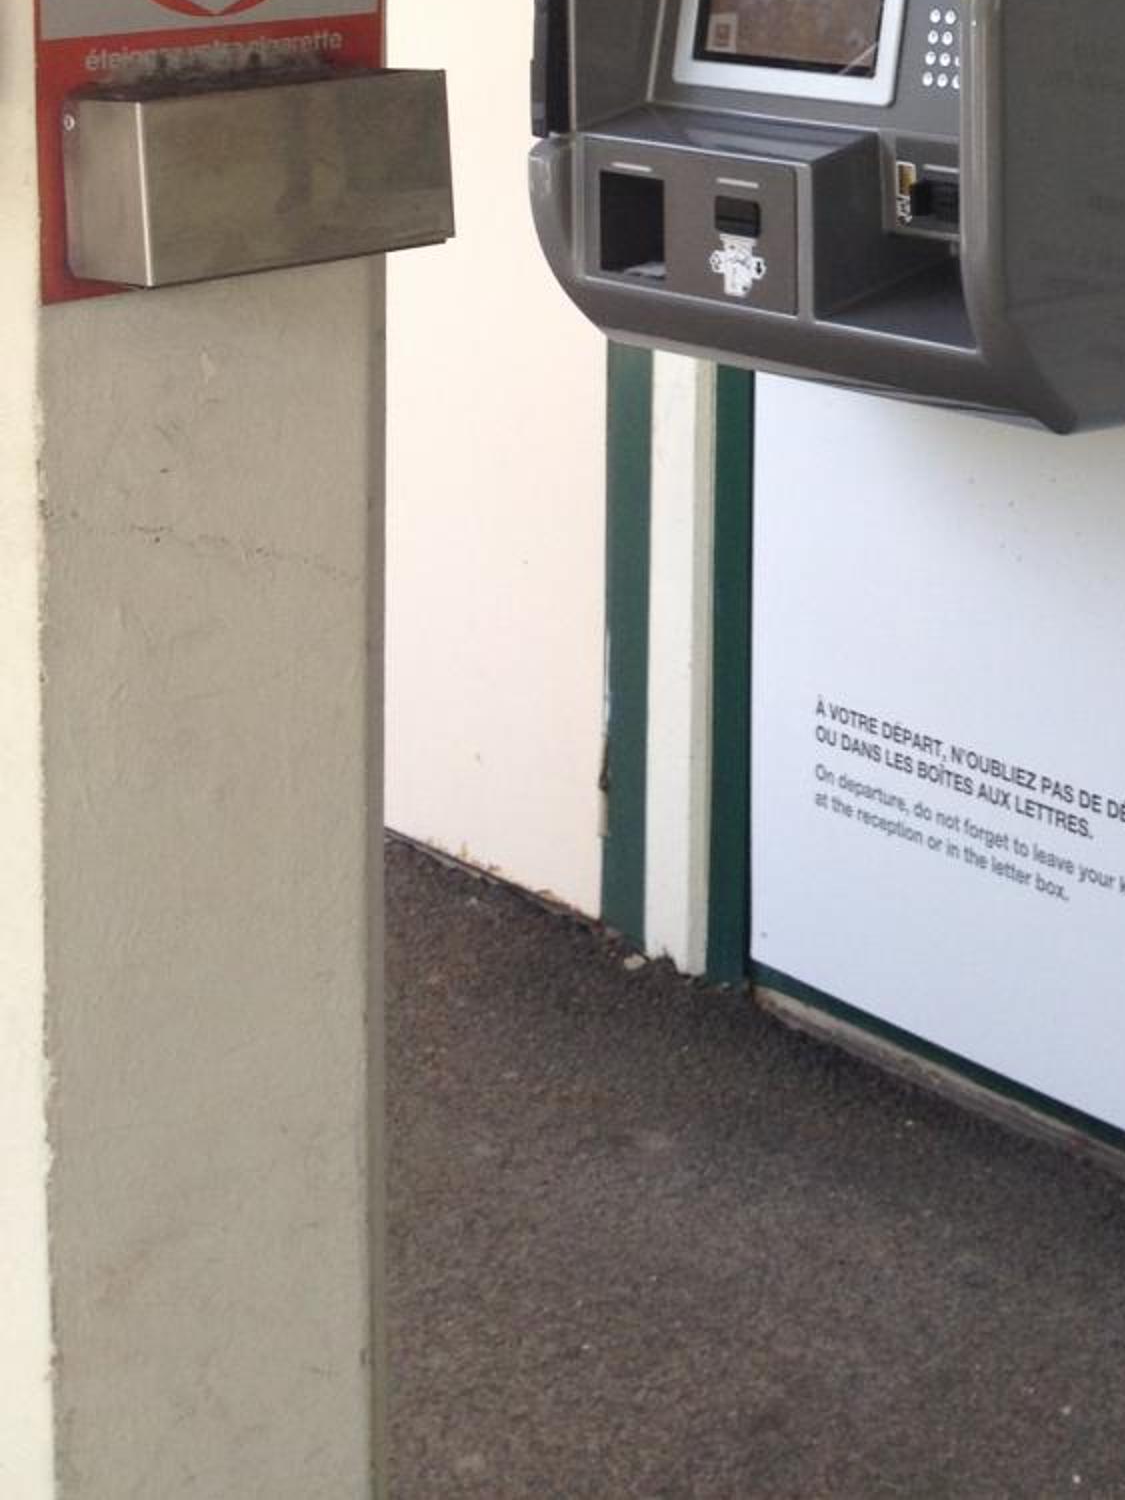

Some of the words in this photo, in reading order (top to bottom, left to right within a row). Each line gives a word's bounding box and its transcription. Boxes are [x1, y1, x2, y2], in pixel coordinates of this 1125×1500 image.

[815, 725, 837, 748] OU
[841, 734, 881, 764] DANS
[885, 750, 913, 776] LES
[977, 782, 1011, 808] AUX
[1015, 795, 1094, 840] LETTRES.
[829, 702, 879, 736] VOTRE
[882, 719, 948, 763] DÉPART,
[951, 745, 1038, 792] N'OUBLIEZ
[1041, 776, 1074, 805] PAS
[1079, 789, 1102, 814] DE
[815, 763, 835, 785] On
[838, 770, 910, 817] departure,
[913, 801, 932, 822] do
[936, 809, 961, 834] not
[963, 817, 1009, 851] forget
[1013, 836, 1030, 859] to
[1033, 843, 1075, 876] leave
[1078, 862, 1116, 892] your
[815, 791, 829, 811] at
[832, 796, 854, 819] the
[857, 808, 924, 848] reception
[927, 834, 943, 853] or
[946, 837, 961, 859] in
[963, 845, 988, 871] the
[991, 857, 1032, 887] letter
[1036, 872, 1069, 903] box.
